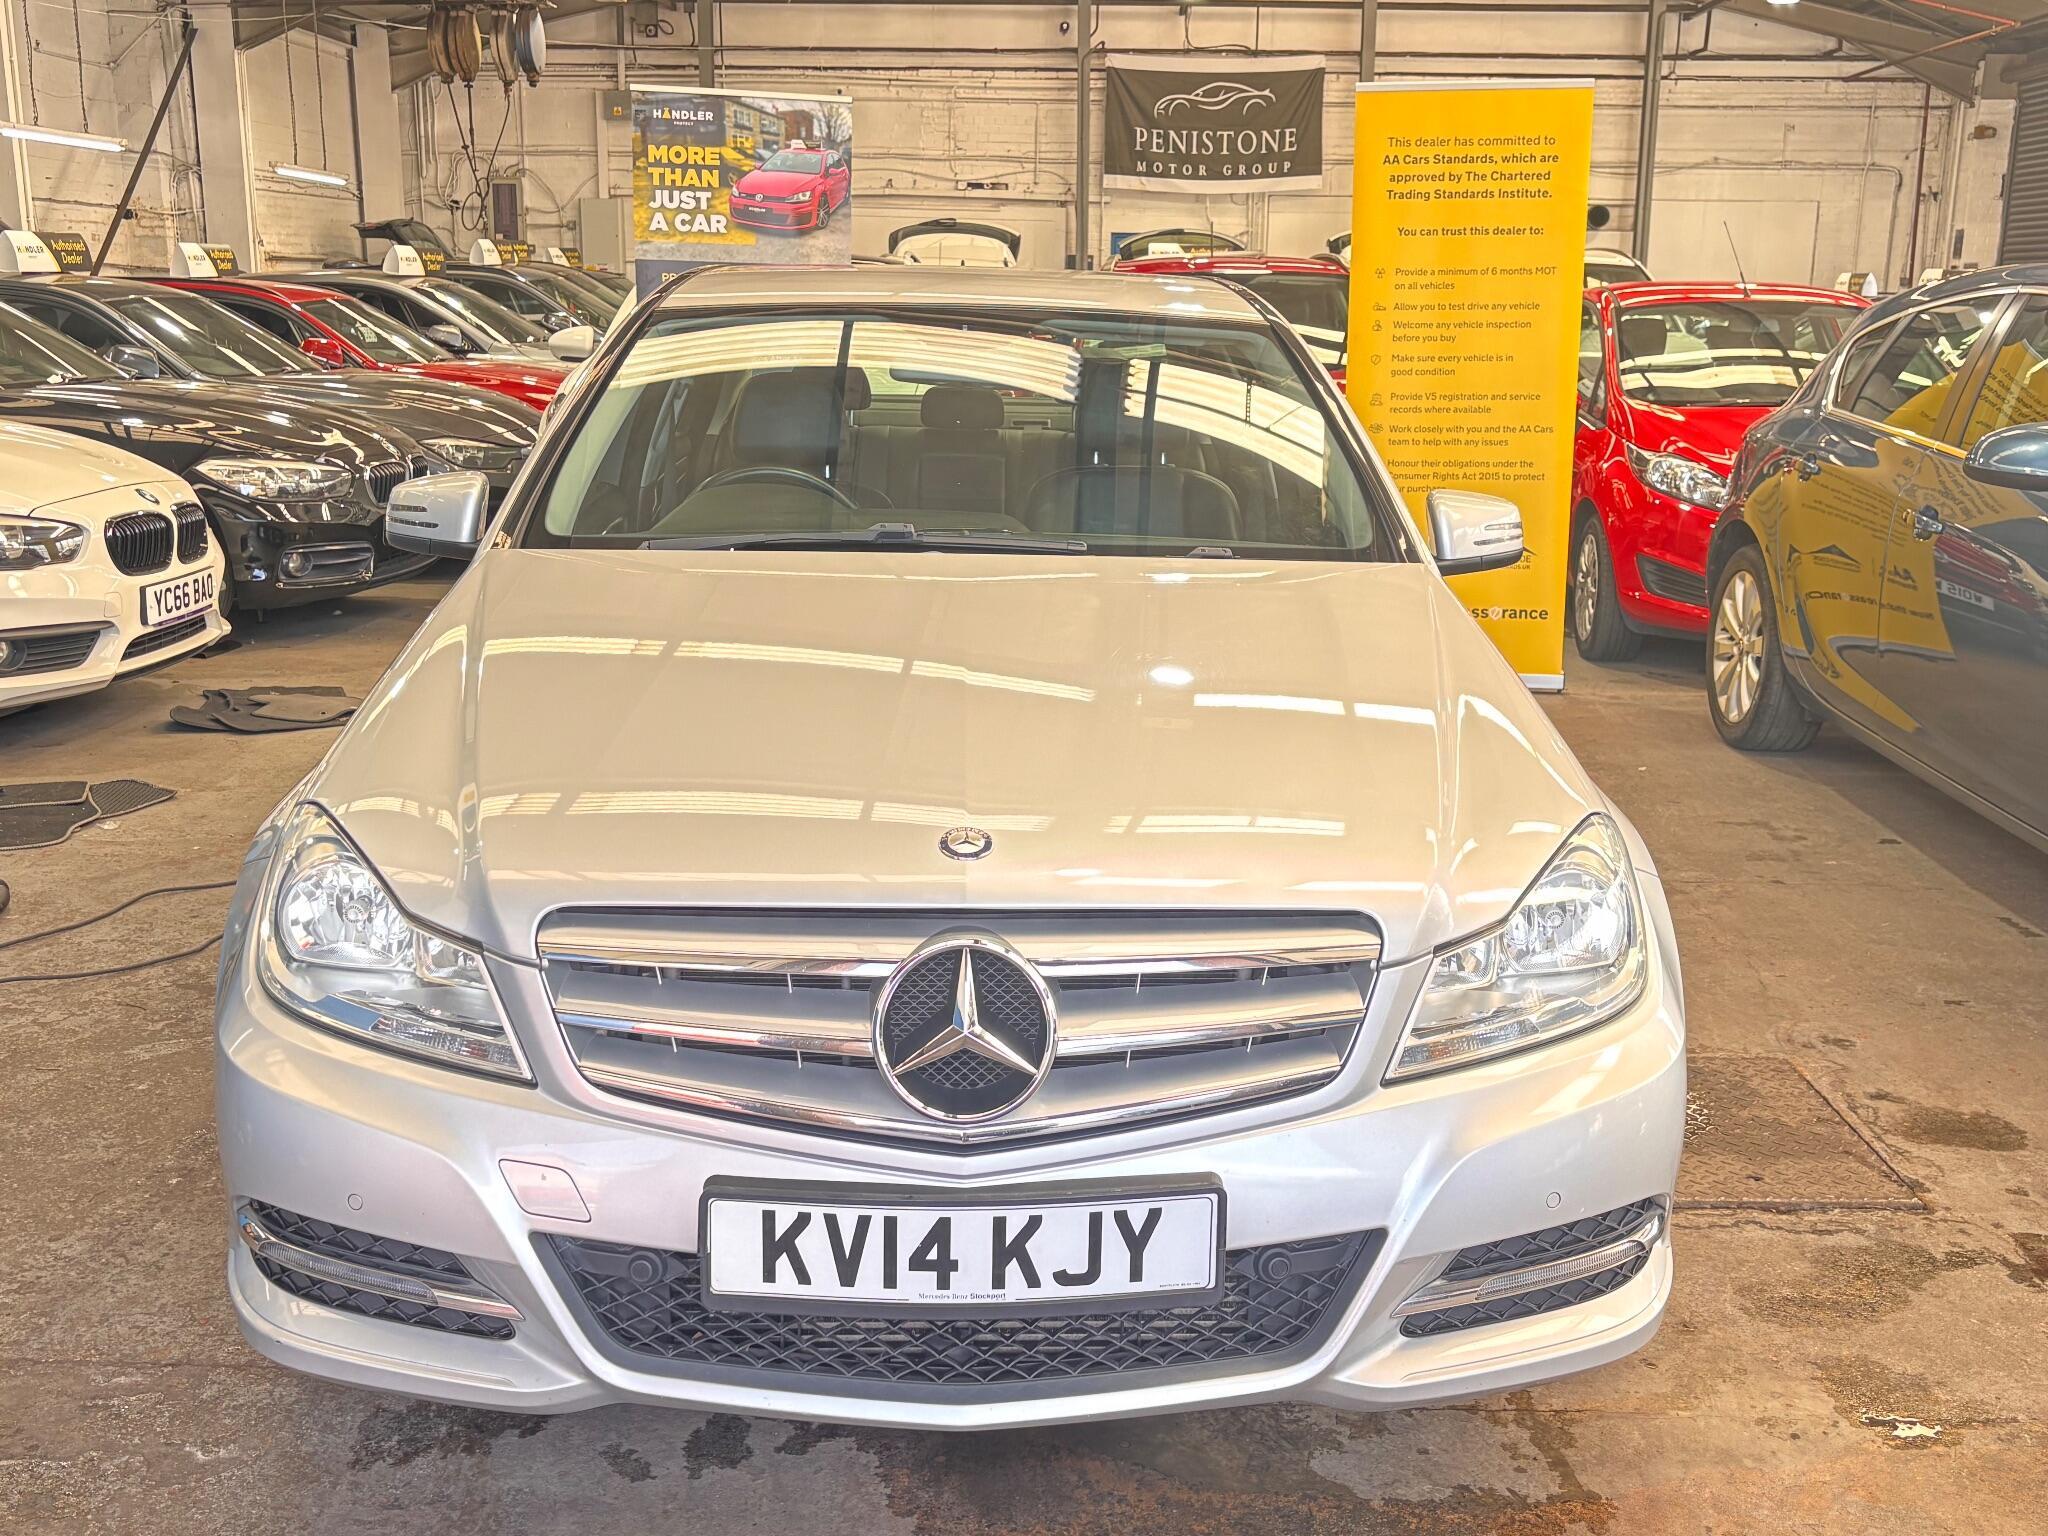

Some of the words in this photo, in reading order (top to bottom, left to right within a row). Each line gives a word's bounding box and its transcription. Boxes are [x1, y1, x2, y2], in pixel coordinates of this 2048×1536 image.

[653, 107, 714, 120] HANDLER
[1134, 127, 1297, 155] PENISTONE
[1388, 137, 1411, 147] This
[1415, 137, 1451, 147] dealer
[1454, 136, 1474, 146] has
[1478, 136, 1540, 146] committed
[1544, 136, 1556, 146] to
[648, 145, 720, 165] MORE
[1383, 155, 1399, 165] AA
[1403, 155, 1429, 164] Cars
[1433, 154, 1498, 165] Standards,
[1501, 154, 1536, 163] which
[1540, 155, 1559, 163] are
[1137, 161, 1207, 176] MOTOR
[1223, 161, 1291, 176] GROUP
[648, 167, 719, 188] THAN
[1389, 173, 1444, 183] approved
[1448, 173, 1462, 183] by
[1465, 172, 1487, 181] The
[1490, 171, 1551, 181] Chartered
[649, 190, 711, 210] JUST
[1387, 190, 1430, 201] Trading
[1434, 189, 1495, 199] Standards
[1498, 189, 1552, 198] Institute.
[649, 213, 669, 232] A
[675, 214, 727, 233] CAR
[1398, 227, 1417, 237] You
[1420, 228, 1439, 236] can
[1442, 228, 1467, 236] trust
[1470, 227, 1489, 235] this
[1492, 227, 1526, 235] dealer
[1529, 227, 1544, 235] to:
[51, 240, 86, 251] Authorised
[62, 252, 83, 264] Dealer
[1395, 268, 1428, 276] Provide
[1438, 268, 1478, 276] minimum
[1491, 267, 1497, 275] 6
[1500, 267, 1532, 275] months
[1535, 267, 1557, 275] MOT
[1420, 281, 1455, 289] vehicles
[1394, 302, 1417, 311] Allow
[1420, 304, 1435, 312] you
[1468, 302, 1489, 310] drive
[1491, 303, 1507, 311] any
[1509, 302, 1540, 310] vehicle
[1393, 321, 1434, 329] Welcome
[1436, 322, 1451, 330] any
[1453, 320, 1483, 329] vehicle
[1486, 320, 1531, 330] inspection
[1392, 334, 1420, 342] before
[1422, 335, 1438, 343] you
[1440, 334, 1456, 343] buy
[1392, 354, 1415, 362] Make
[1438, 355, 1461, 363] every
[1463, 354, 1494, 362] vehicle
[1496, 354, 1503, 362] is
[1505, 354, 1513, 362] in
[1391, 368, 1413, 377] good
[1415, 367, 1455, 376] condition
[1391, 393, 1423, 401] Provide
[1439, 392, 1488, 402] registration
[1424, 405, 1451, 413] where
[1453, 405, 1491, 413] available
[1389, 425, 1412, 433] Work
[1414, 425, 1443, 434] closely
[1445, 425, 1465, 433] with
[1466, 427, 1482, 435] you
[1485, 425, 1501, 433] and
[1503, 425, 1517, 433] the
[1518, 425, 1532, 433] AA
[1534, 425, 1553, 433] Cars
[1412, 438, 1421, 446] to
[1423, 438, 1442, 447] help
[1443, 438, 1462, 446] with
[1464, 439, 1479, 447] any
[1482, 438, 1508, 446] issues
[1388, 459, 1419, 467] Honour
[1421, 459, 1440, 467] their
[1443, 459, 1490, 469] obligations
[1493, 459, 1518, 467] under
[1520, 459, 1534, 467] the
[1433, 472, 1460, 482] Rights
[1462, 472, 1476, 480] Act
[1479, 472, 1501, 480] 2015
[1513, 472, 1545, 482] protect
[154, 582, 190, 616] YC66
[193, 573, 214, 604] BAO
[762, 1209, 959, 1290] KV14
[991, 1207, 1163, 1289] KJY
[970, 1292, 1006, 1300] Stockport
